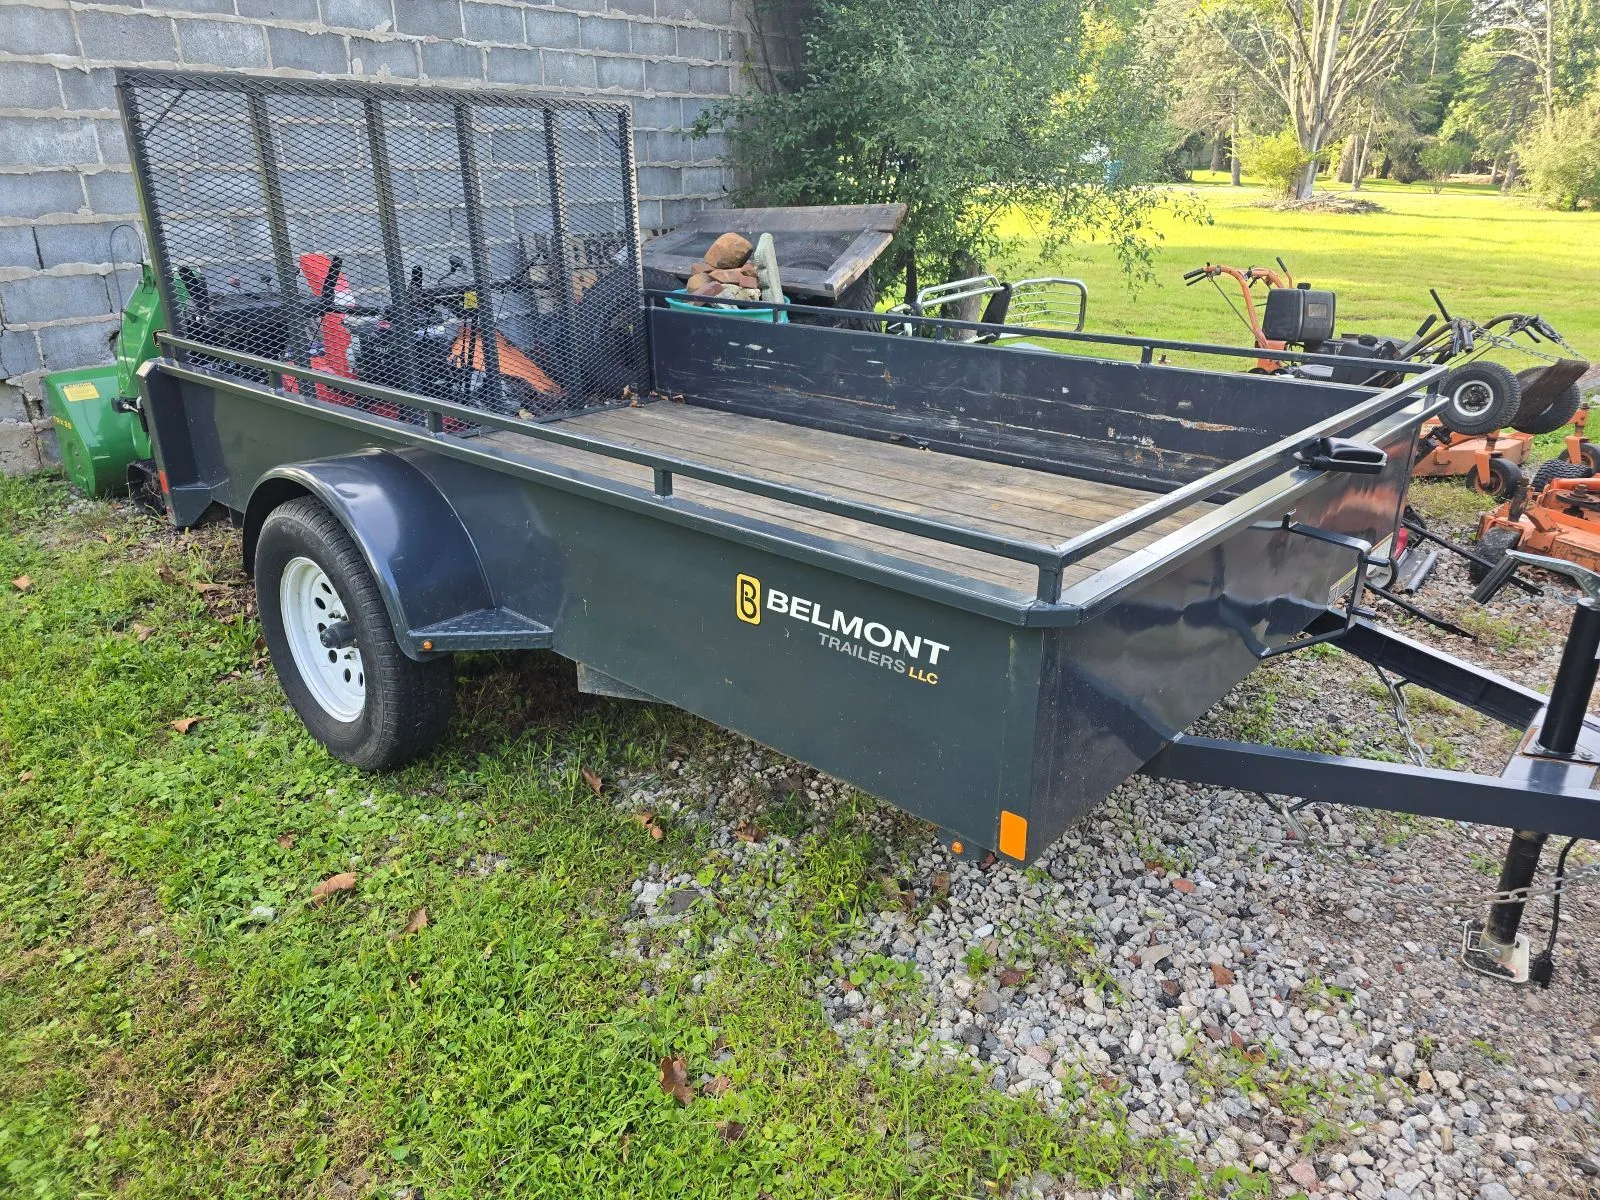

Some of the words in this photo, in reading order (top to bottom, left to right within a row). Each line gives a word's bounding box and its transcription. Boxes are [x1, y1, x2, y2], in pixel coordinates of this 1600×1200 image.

[766, 588, 950, 665] BELMONT
[818, 631, 906, 674] TRAILERS
[908, 666, 939, 685] LLC
